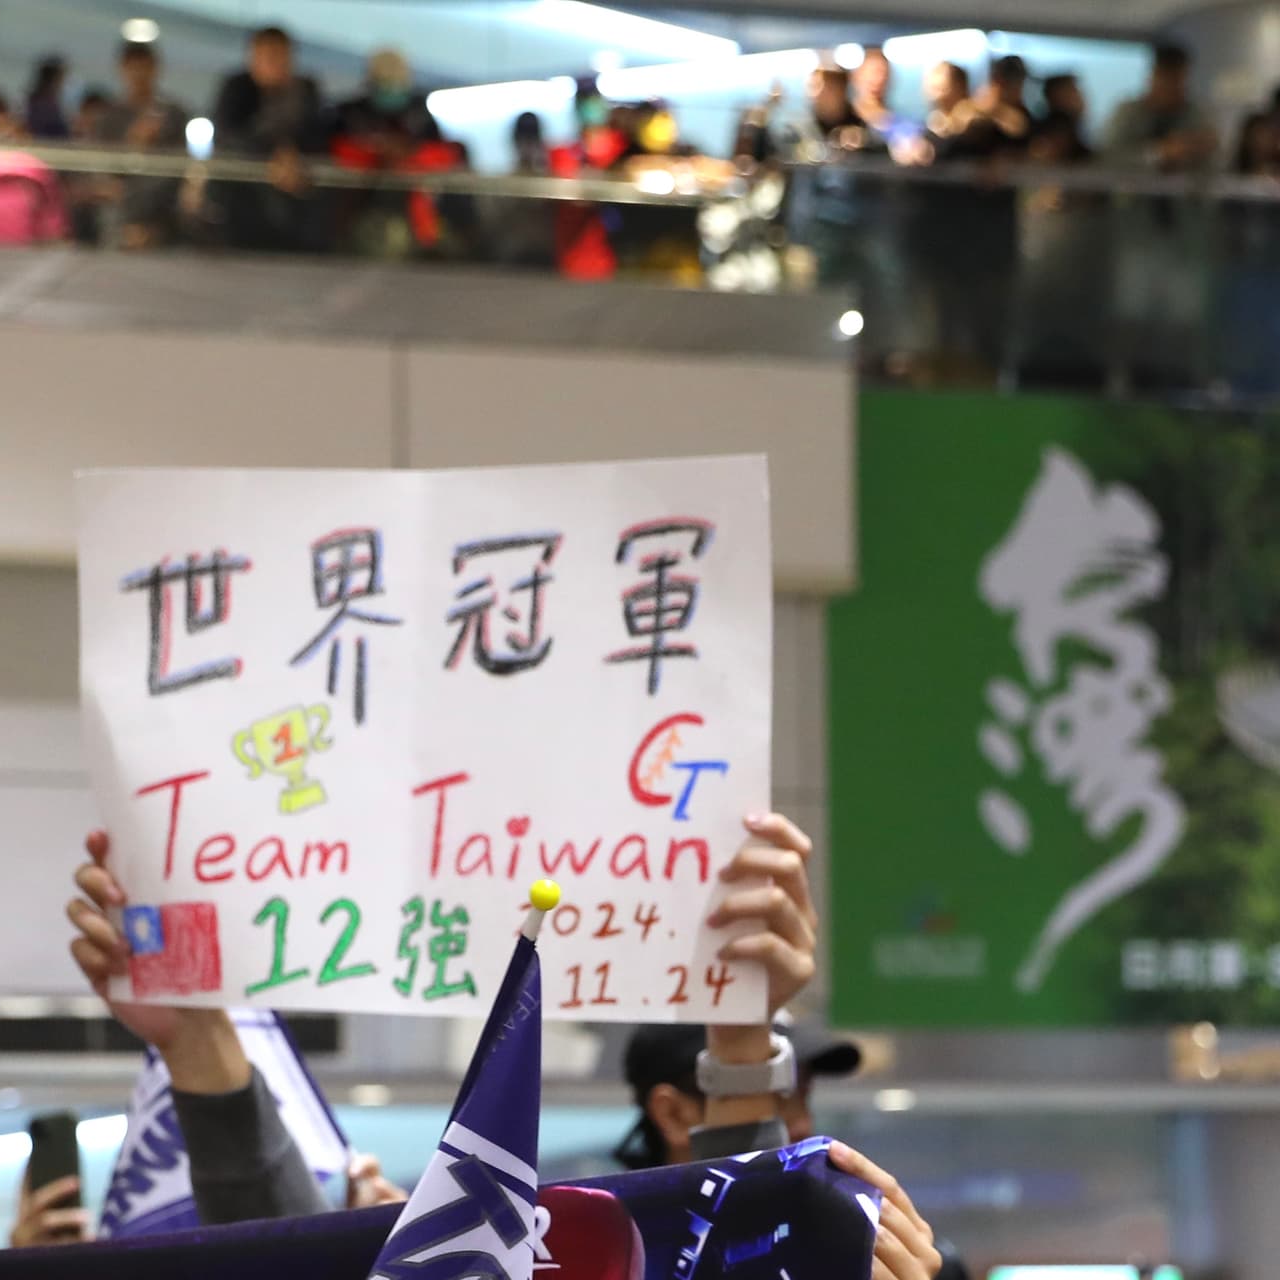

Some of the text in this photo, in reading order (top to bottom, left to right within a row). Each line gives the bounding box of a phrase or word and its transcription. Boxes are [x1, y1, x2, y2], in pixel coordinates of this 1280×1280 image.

[122, 516, 715, 725] 世界冠軍
[136, 770, 712, 884] Team Taiwan
[244, 895, 479, 1000] 12強
[514, 900, 677, 942] 024.
